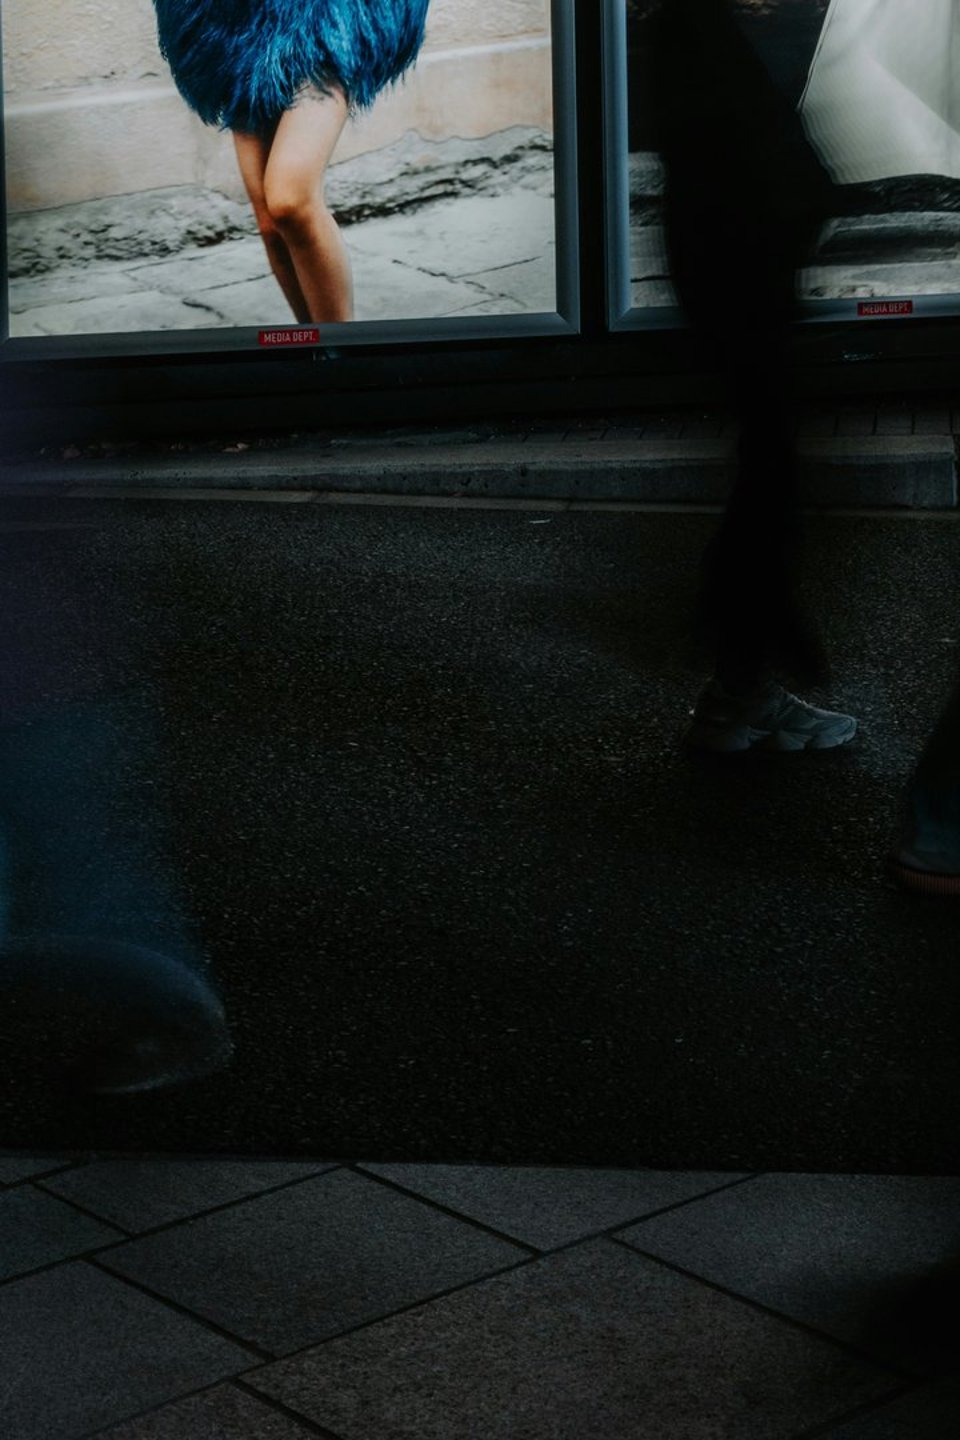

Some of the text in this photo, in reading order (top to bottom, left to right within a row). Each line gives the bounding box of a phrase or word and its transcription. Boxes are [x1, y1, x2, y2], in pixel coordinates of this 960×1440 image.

[862, 303, 888, 314] MEDIA
[264, 331, 316, 343] MEDIA DEPT.
